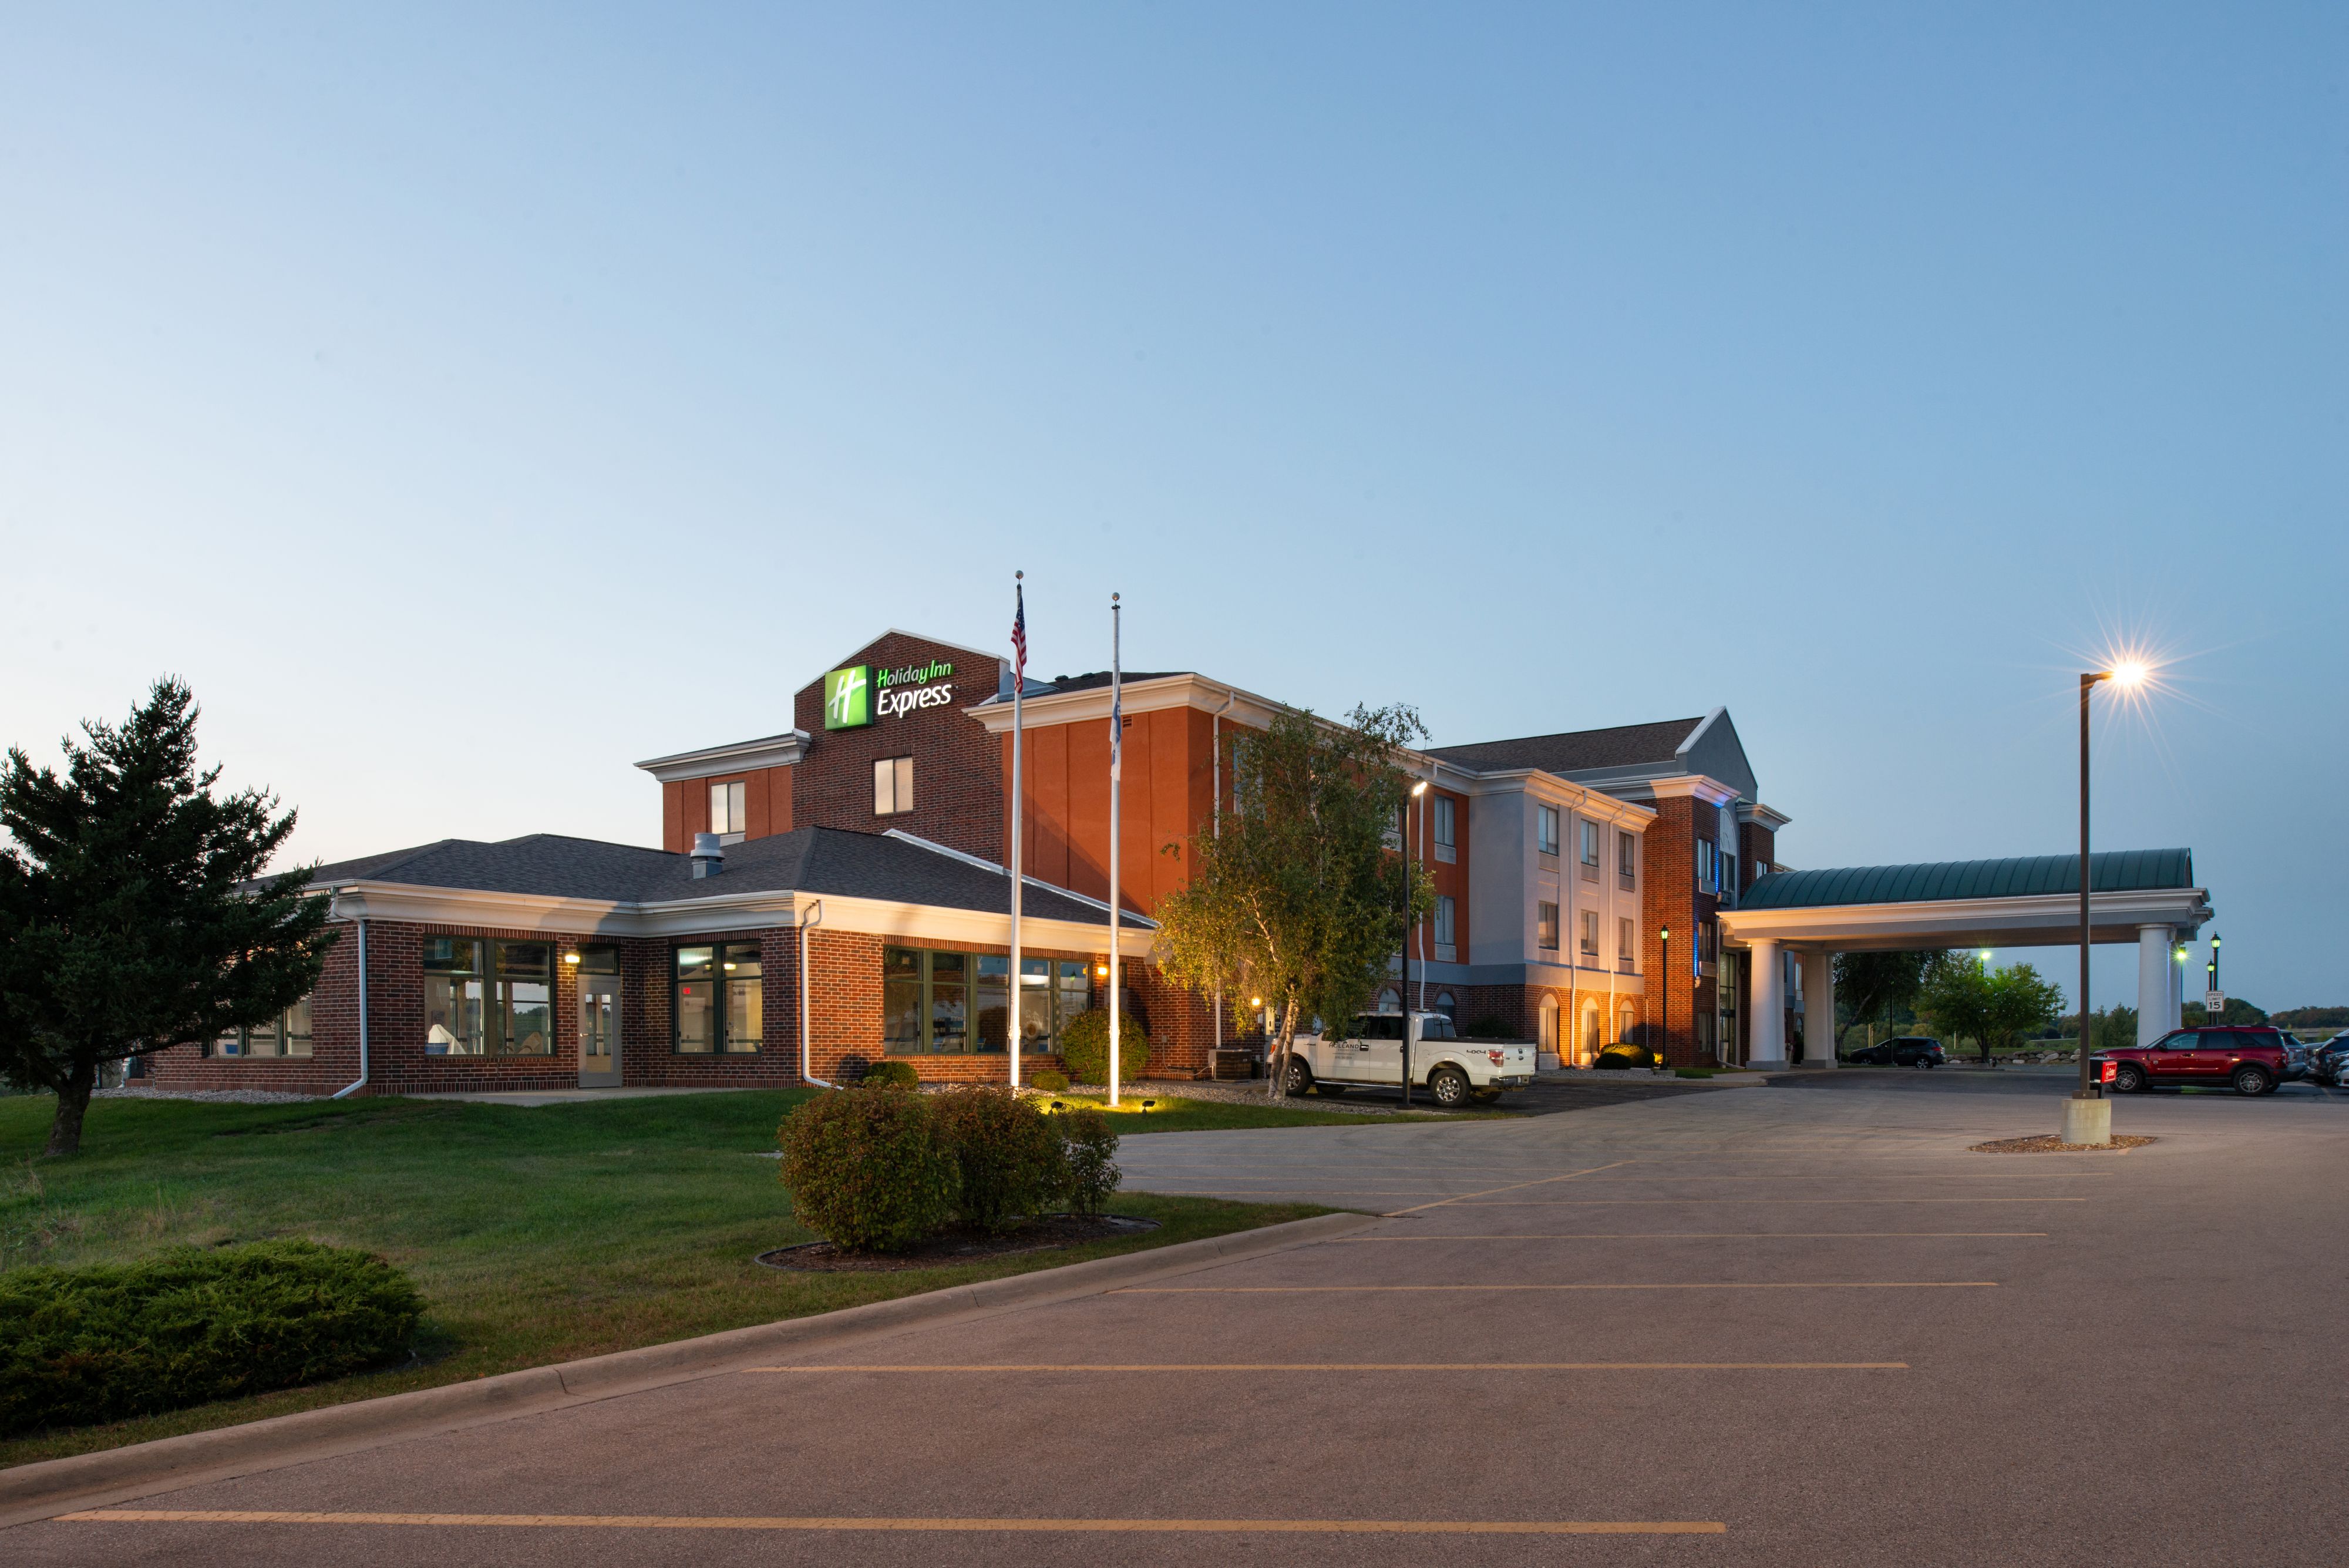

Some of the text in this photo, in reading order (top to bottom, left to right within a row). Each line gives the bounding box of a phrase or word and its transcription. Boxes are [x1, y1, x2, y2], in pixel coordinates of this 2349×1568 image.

[877, 659, 952, 688] Holiday Inn
[877, 684, 952, 718] Express
[2209, 1001, 2220, 1010] 15
